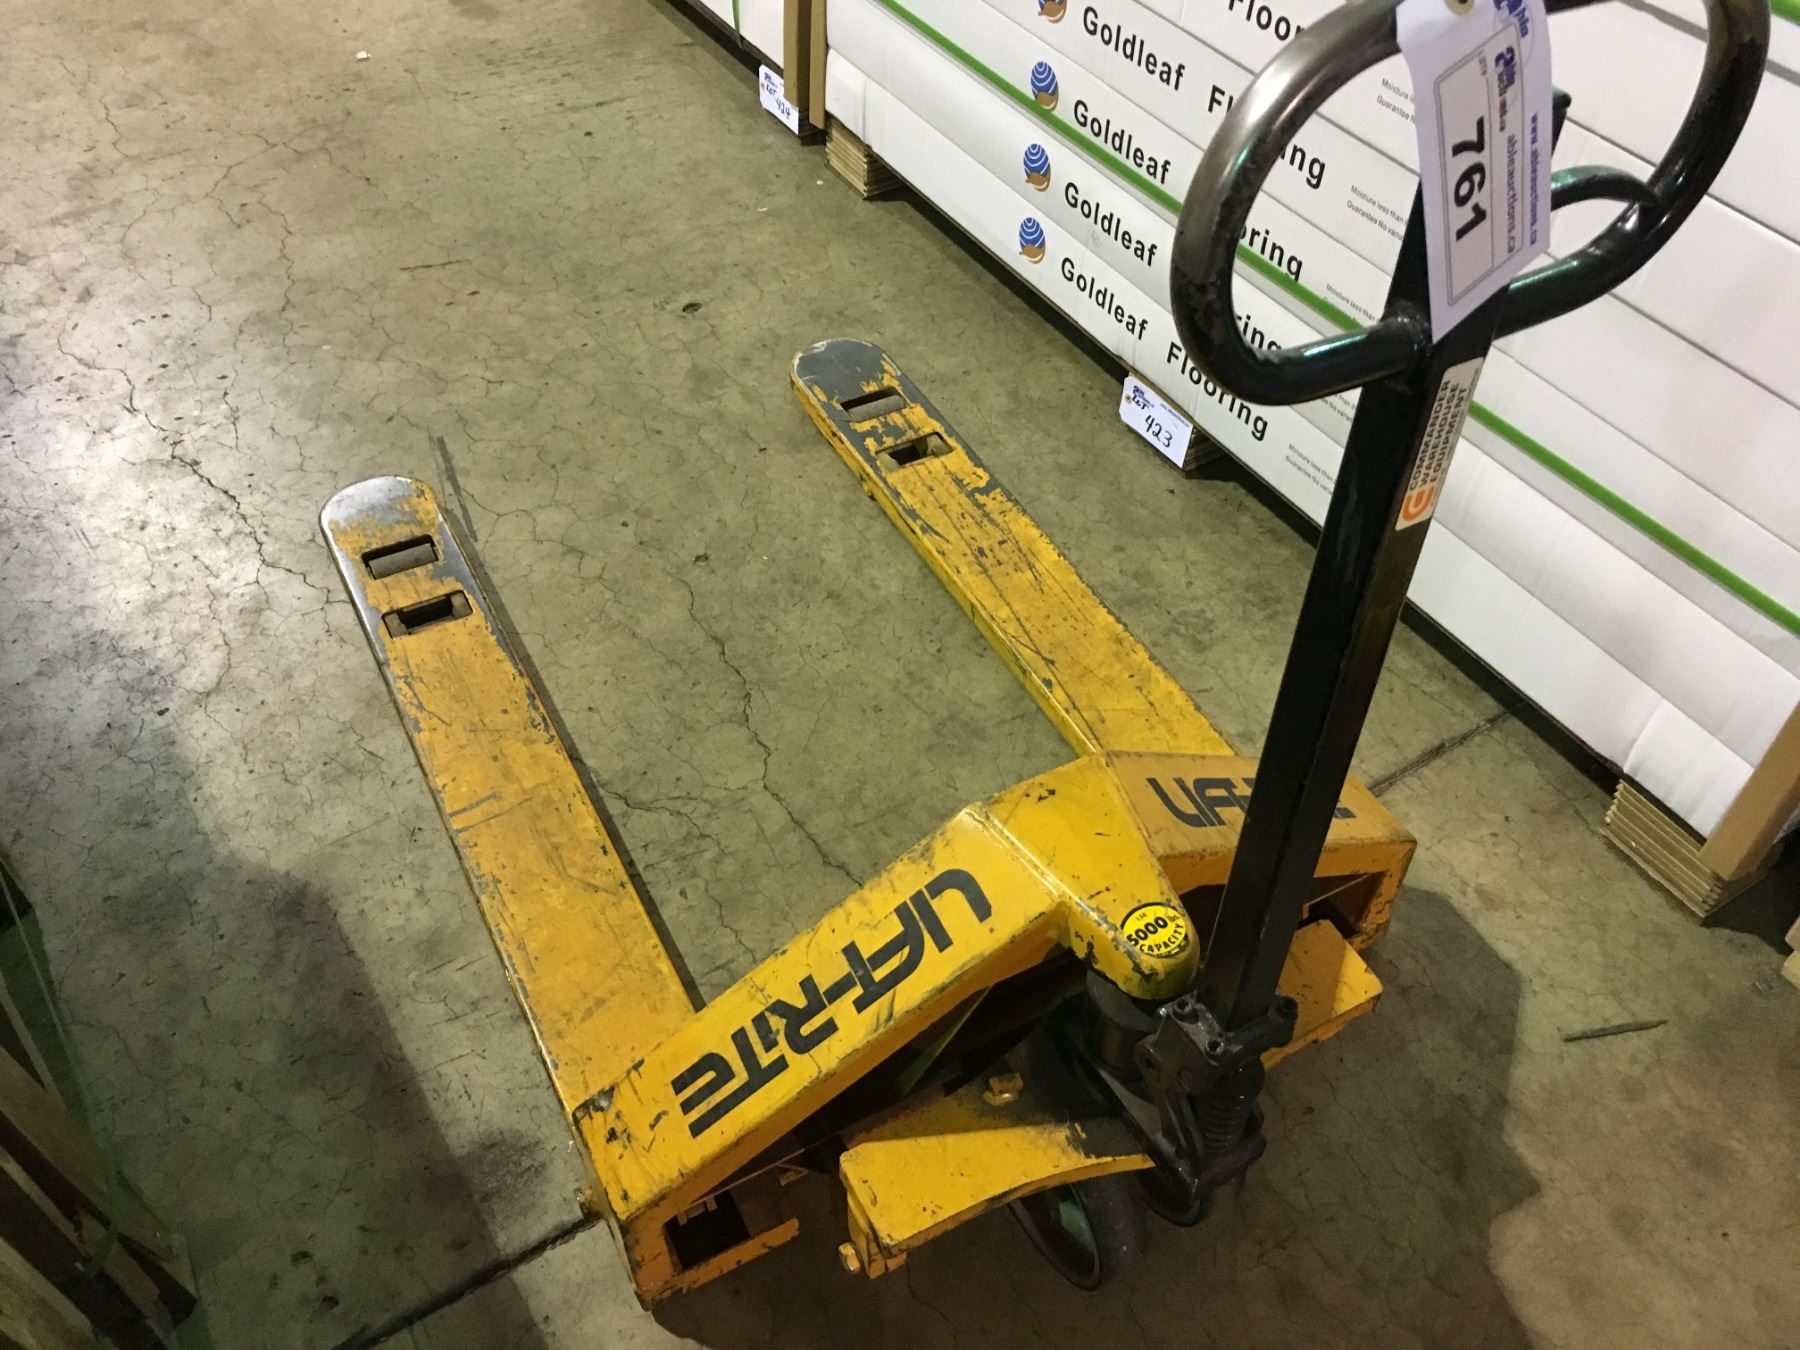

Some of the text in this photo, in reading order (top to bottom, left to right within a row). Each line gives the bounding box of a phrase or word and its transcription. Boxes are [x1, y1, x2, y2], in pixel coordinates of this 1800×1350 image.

[1083, 6, 1185, 91] Goldleaf
[1381, 78, 1410, 100] Moisture
[1073, 99, 1171, 185] Goldleaf
[1451, 115, 1487, 242] 761
[1064, 182, 1158, 268] Goldleaf
[1350, 184, 1377, 206] Moisture
[1377, 201, 1390, 215] less
[1389, 210, 1404, 224] than
[1507, 133, 1518, 254] ableauctions.ca
[1060, 257, 1269, 442] Goldleaf Flooring
[1145, 414, 1173, 449] 423
[1408, 379, 1451, 491] COMMANDER
[1419, 382, 1460, 488] WAREHOUSE
[1430, 387, 1468, 483] EQUIPMENT
[1126, 916, 1169, 947] 5000
[1139, 923, 1185, 953] CAPACITY
